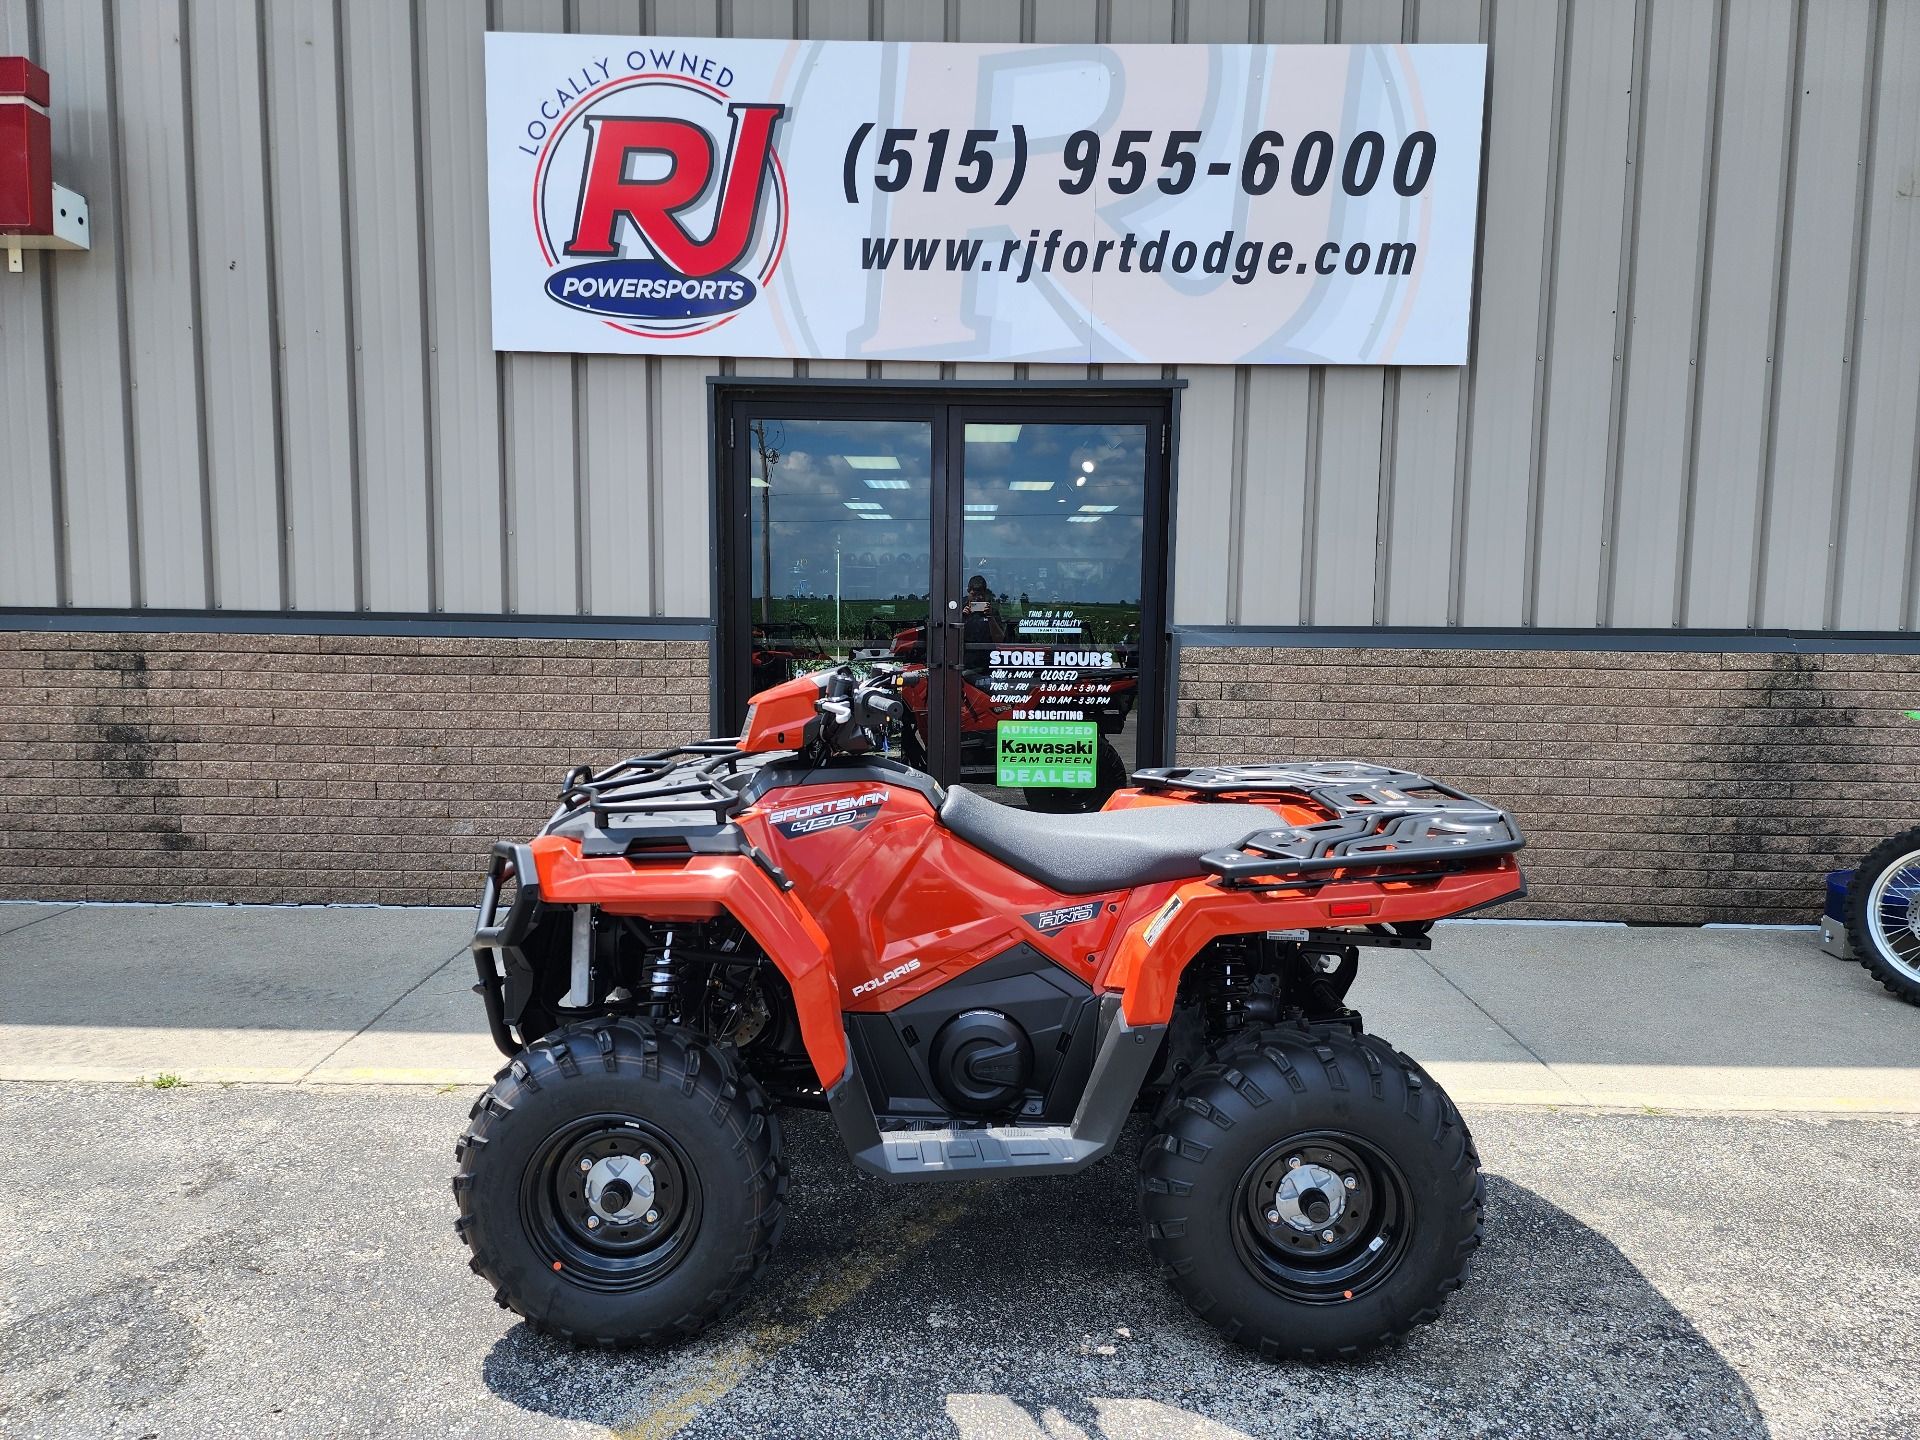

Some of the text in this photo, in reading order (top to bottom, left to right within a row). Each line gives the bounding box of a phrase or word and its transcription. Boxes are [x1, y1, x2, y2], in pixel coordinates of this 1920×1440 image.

[519, 48, 734, 156] LOCALLY OWNED
[842, 123, 1437, 206] (515) 955-6000
[562, 103, 786, 276] RJ
[861, 229, 1418, 285] www.rjfortdodge.com
[562, 278, 745, 301] POWERSPORTS
[1055, 610, 1061, 618] A
[1019, 619, 1082, 627] SMOKING FACILITY
[989, 651, 1113, 667] STORE HOURS
[990, 670, 1008, 679] SUN
[1040, 670, 1079, 681] CLOSED
[990, 682, 1008, 691] TUES
[1015, 682, 1029, 691] FRI
[1057, 683, 1073, 692] AM
[1096, 684, 1112, 693] PM
[989, 694, 1032, 704] SATURDAY
[1056, 695, 1073, 705] AM
[1096, 696, 1111, 705] PM
[1012, 710, 1084, 721] NO SOLICITING
[1001, 726, 1093, 735] AUTHORIZED
[1001, 739, 1093, 755] Kawasaki
[1002, 756, 1040, 764] TEAM
[1000, 769, 1093, 784] DEALER
[768, 791, 890, 824] SPORTSMAN
[790, 810, 857, 832] 450
[1038, 909, 1093, 928] AWD
[852, 958, 921, 997] POLARIS
